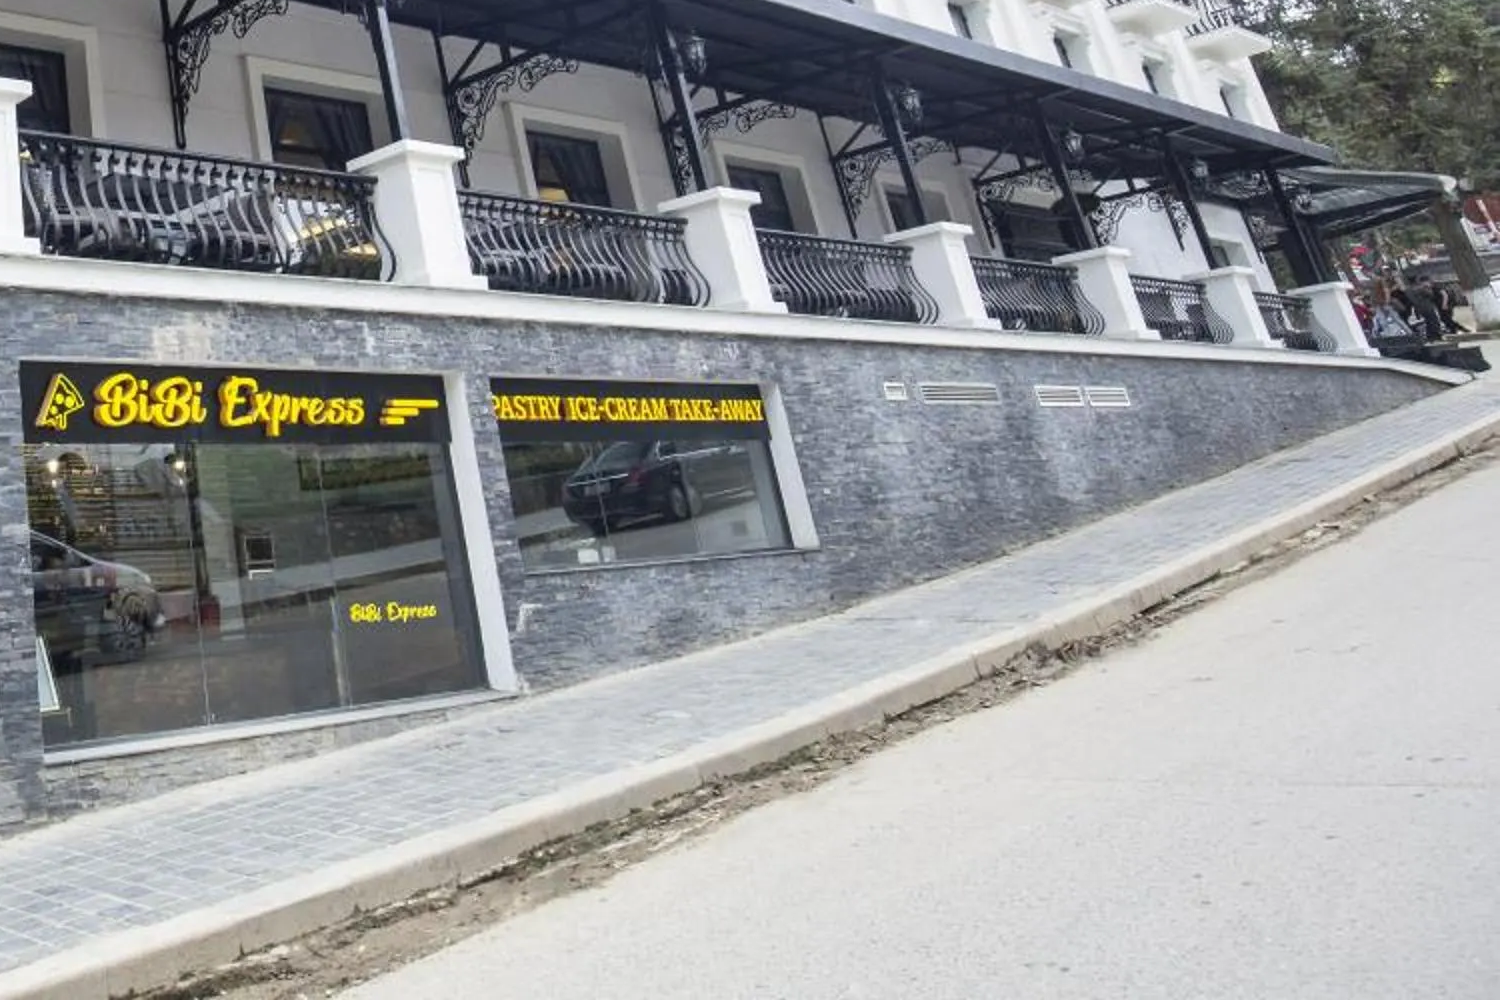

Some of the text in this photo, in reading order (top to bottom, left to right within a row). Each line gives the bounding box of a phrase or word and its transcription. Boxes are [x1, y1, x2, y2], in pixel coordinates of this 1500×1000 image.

[94, 372, 366, 437] BiBi Express
[491, 395, 765, 421] PASTRY ICE-CREAM TAKE-AWAY
